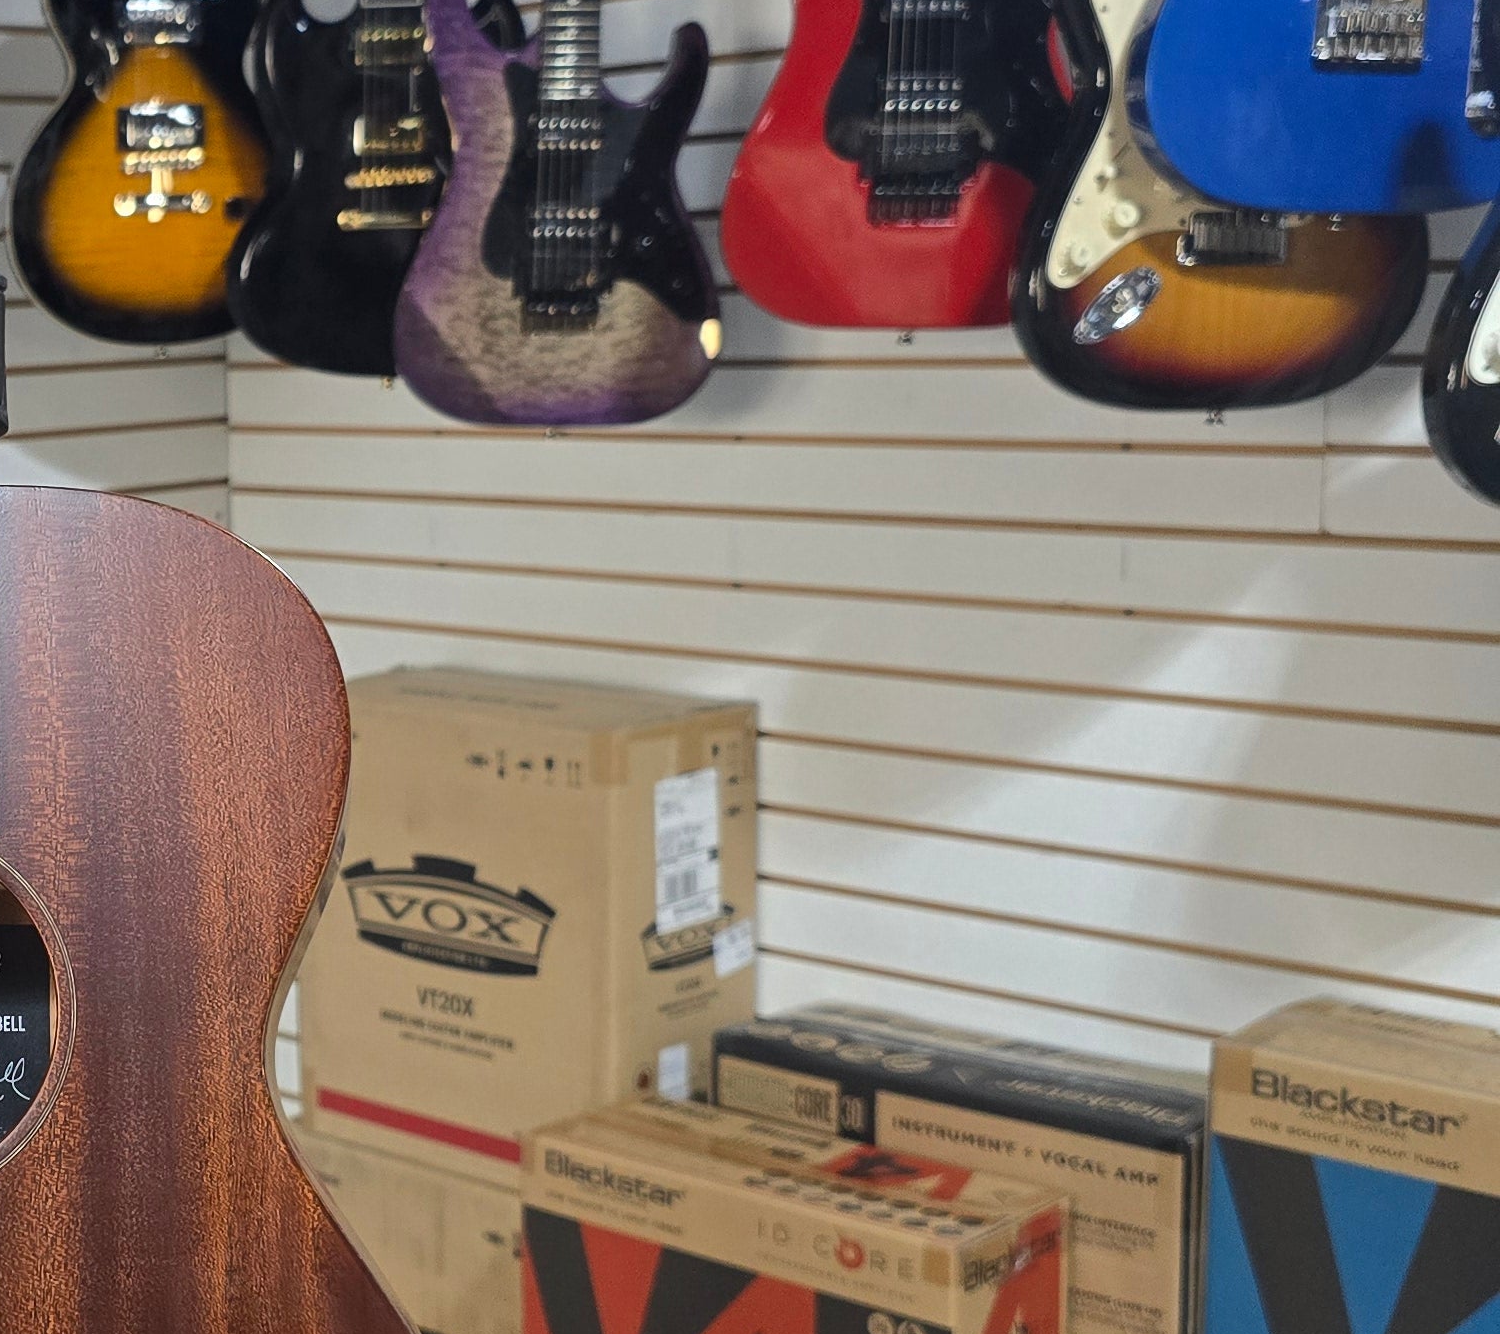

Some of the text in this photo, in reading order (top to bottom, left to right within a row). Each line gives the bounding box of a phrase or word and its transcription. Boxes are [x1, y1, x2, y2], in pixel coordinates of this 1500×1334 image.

[371, 891, 521, 945] VOX
[1252, 1068, 1461, 1136] Blackstar
[544, 1148, 687, 1208] Blackstar
[891, 1116, 1016, 1156] INSTRUMENT
[1040, 1149, 1106, 1177] VOCAL
[1114, 1166, 1160, 1187] AMP
